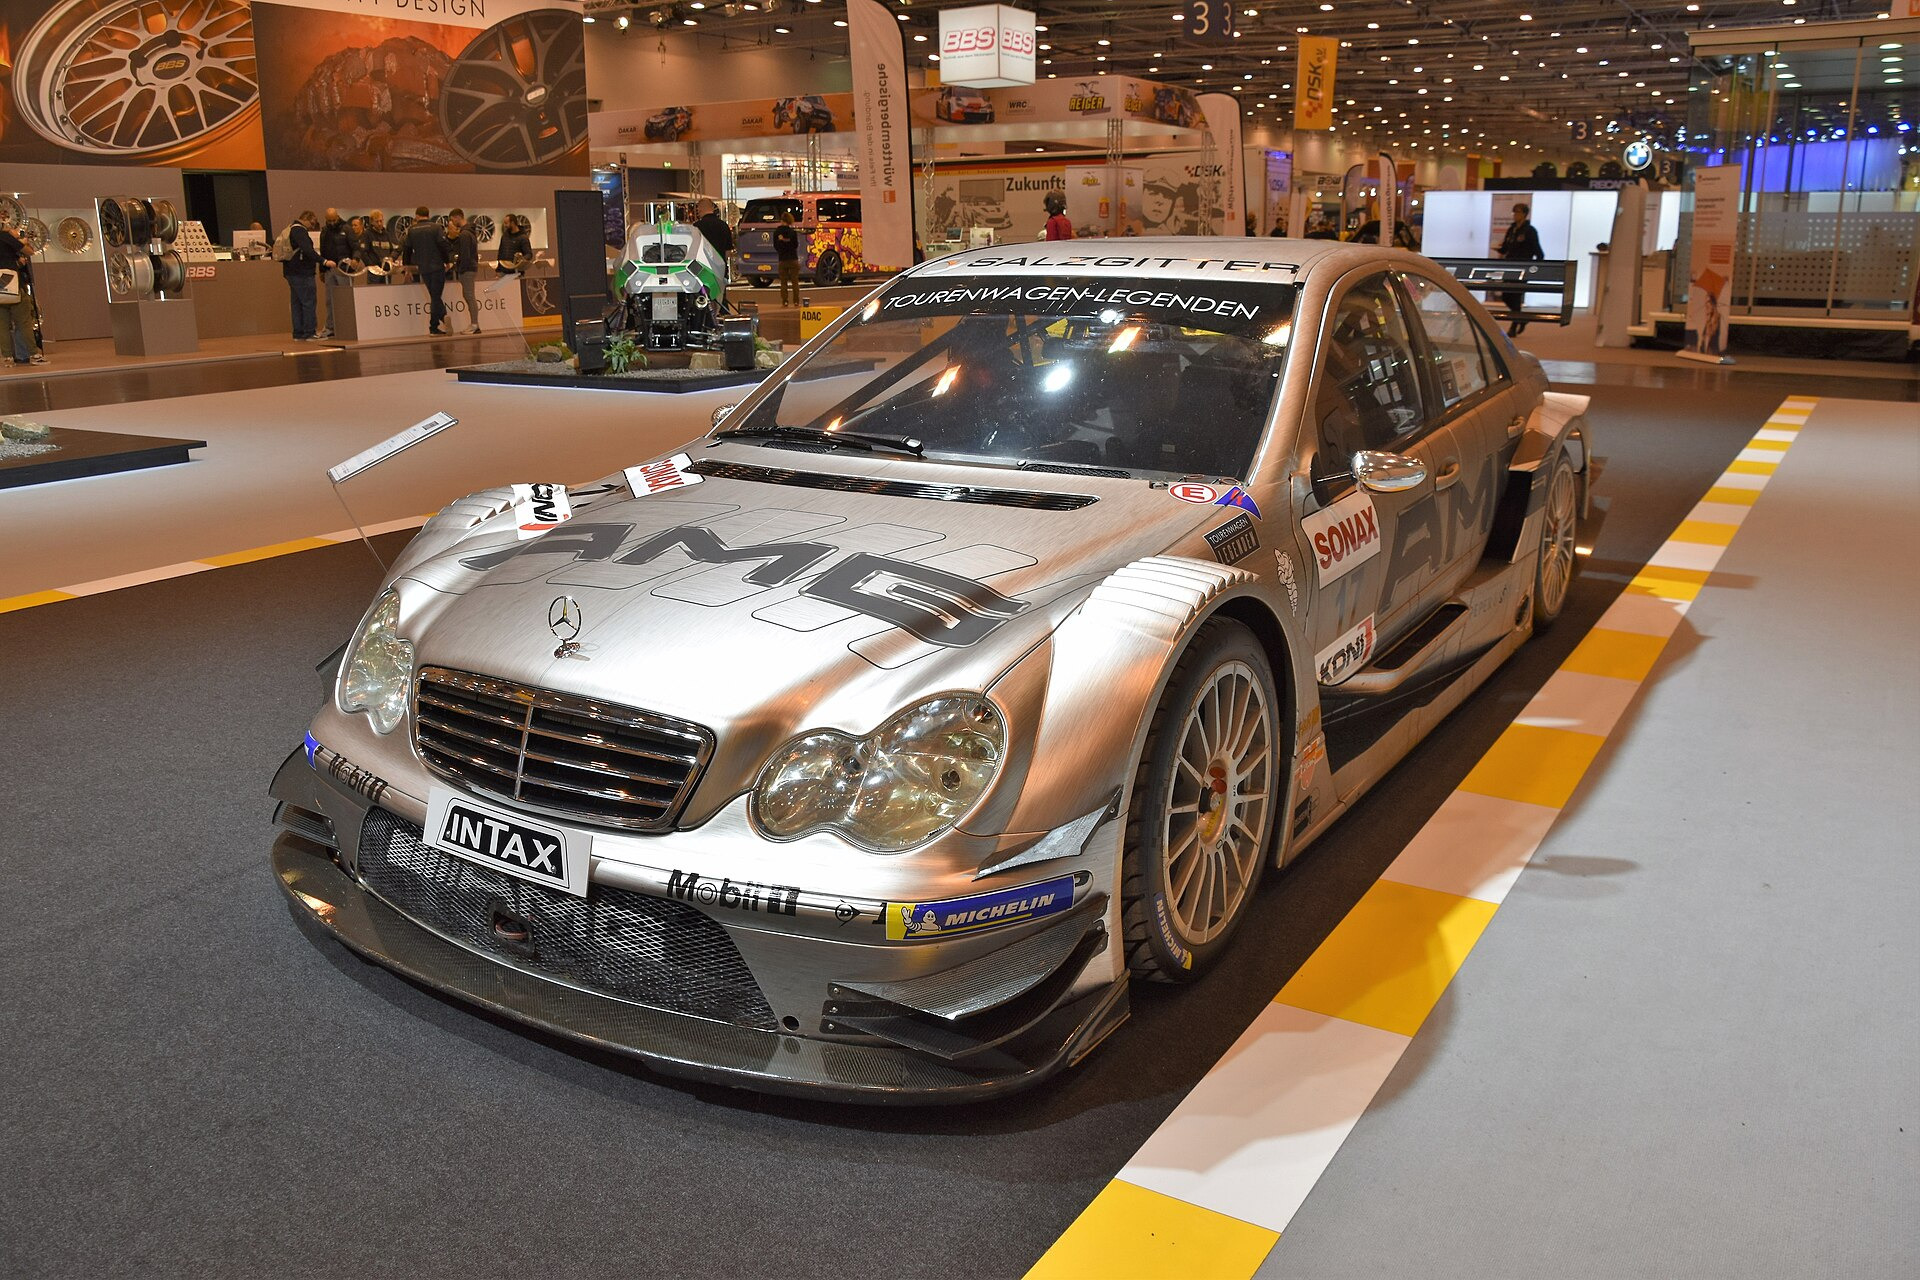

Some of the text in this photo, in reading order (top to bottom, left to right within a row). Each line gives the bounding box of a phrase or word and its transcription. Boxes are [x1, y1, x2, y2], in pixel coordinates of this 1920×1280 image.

[1193, 1, 1210, 35] 3
[1223, 2, 1232, 36] 3
[942, 26, 996, 53] BBS
[1001, 27, 1034, 55] BBS
[742, 117, 763, 125] DAKAR
[1068, 96, 1105, 112] REIGER
[618, 126, 637, 134] DAKAR
[1576, 121, 1588, 140] 3
[1662, 160, 1671, 174] 3
[967, 256, 1301, 275] SALZGITTER
[374, 298, 506, 318] BBS TECNOOGIE
[801, 311, 822, 321] ADAC
[883, 285, 1260, 321] TOURENWAGEN-LEGENDEN
[1208, 517, 1249, 545] TOURENWAGEN
[1218, 530, 1258, 565] LEGENDEN
[1314, 505, 1379, 570] SONAX
[1377, 450, 1502, 616] AM
[459, 522, 1032, 648] AMG
[1319, 633, 1365, 684] KONI
[449, 812, 558, 874] INTAX
[666, 869, 759, 912] Mobil
[944, 893, 1056, 927] MICHELIN
[1156, 899, 1183, 960] MICHELIN
